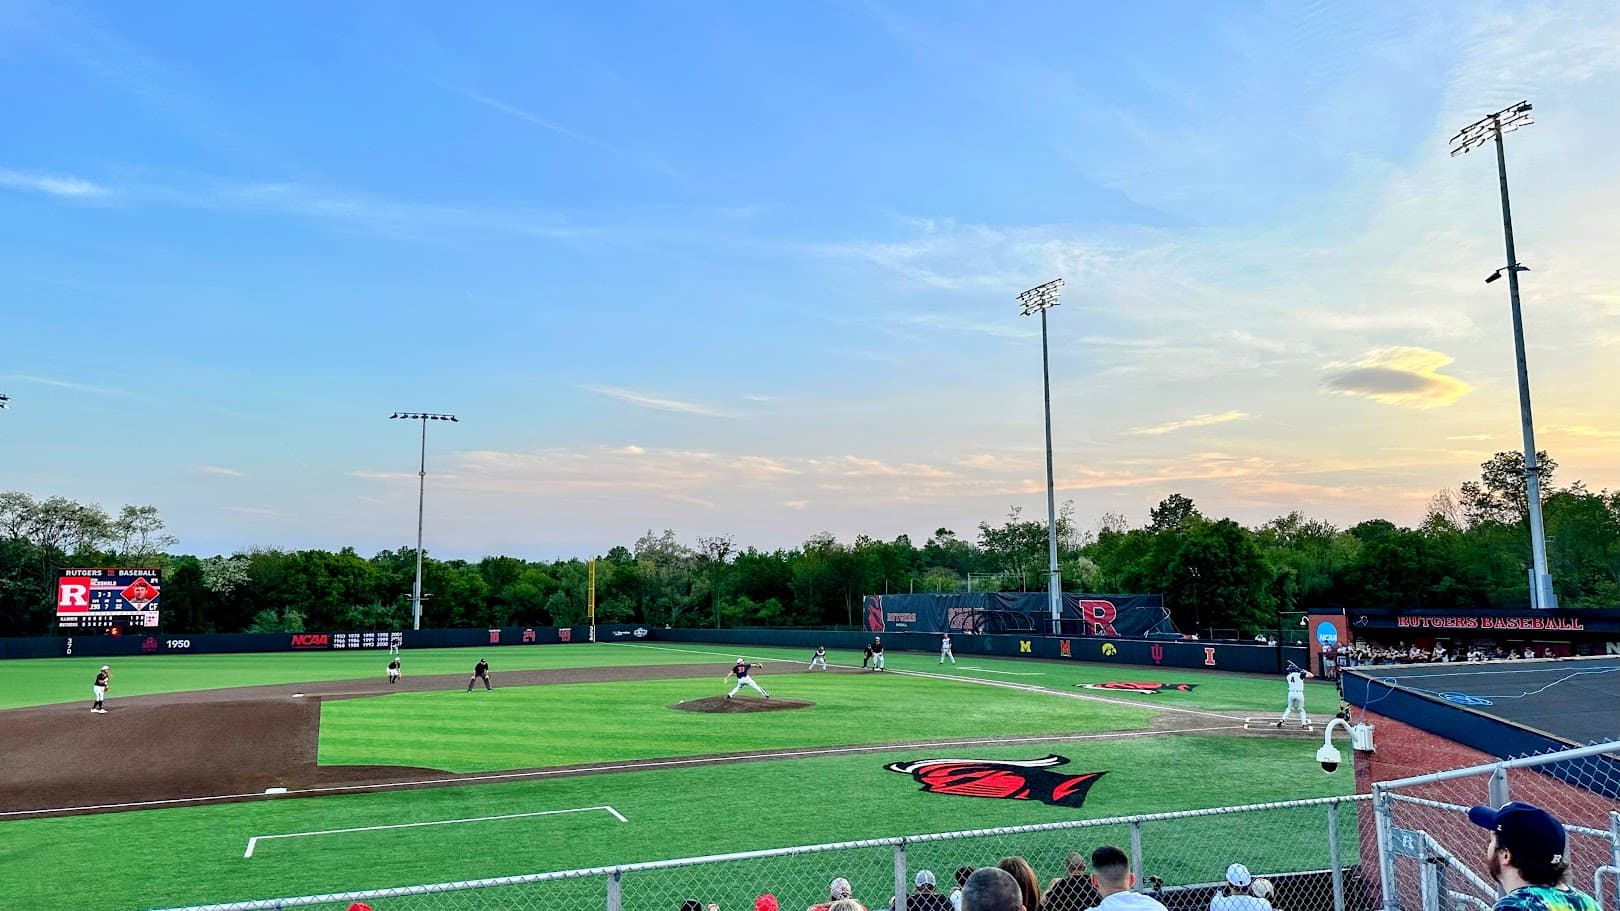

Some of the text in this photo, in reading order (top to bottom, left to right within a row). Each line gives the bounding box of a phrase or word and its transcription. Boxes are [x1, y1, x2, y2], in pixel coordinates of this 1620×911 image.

[60, 584, 88, 606] R
[148, 602, 159, 611] CF
[1079, 600, 1121, 637] R
[1397, 616, 1584, 631] RUTGERS BASEBALL
[291, 634, 328, 645] NCAA
[522, 630, 536, 642] 24
[166, 639, 190, 649] 1950
[1020, 640, 1032, 653] M
[1204, 647, 1216, 666] I
[1401, 833, 1415, 849] R
